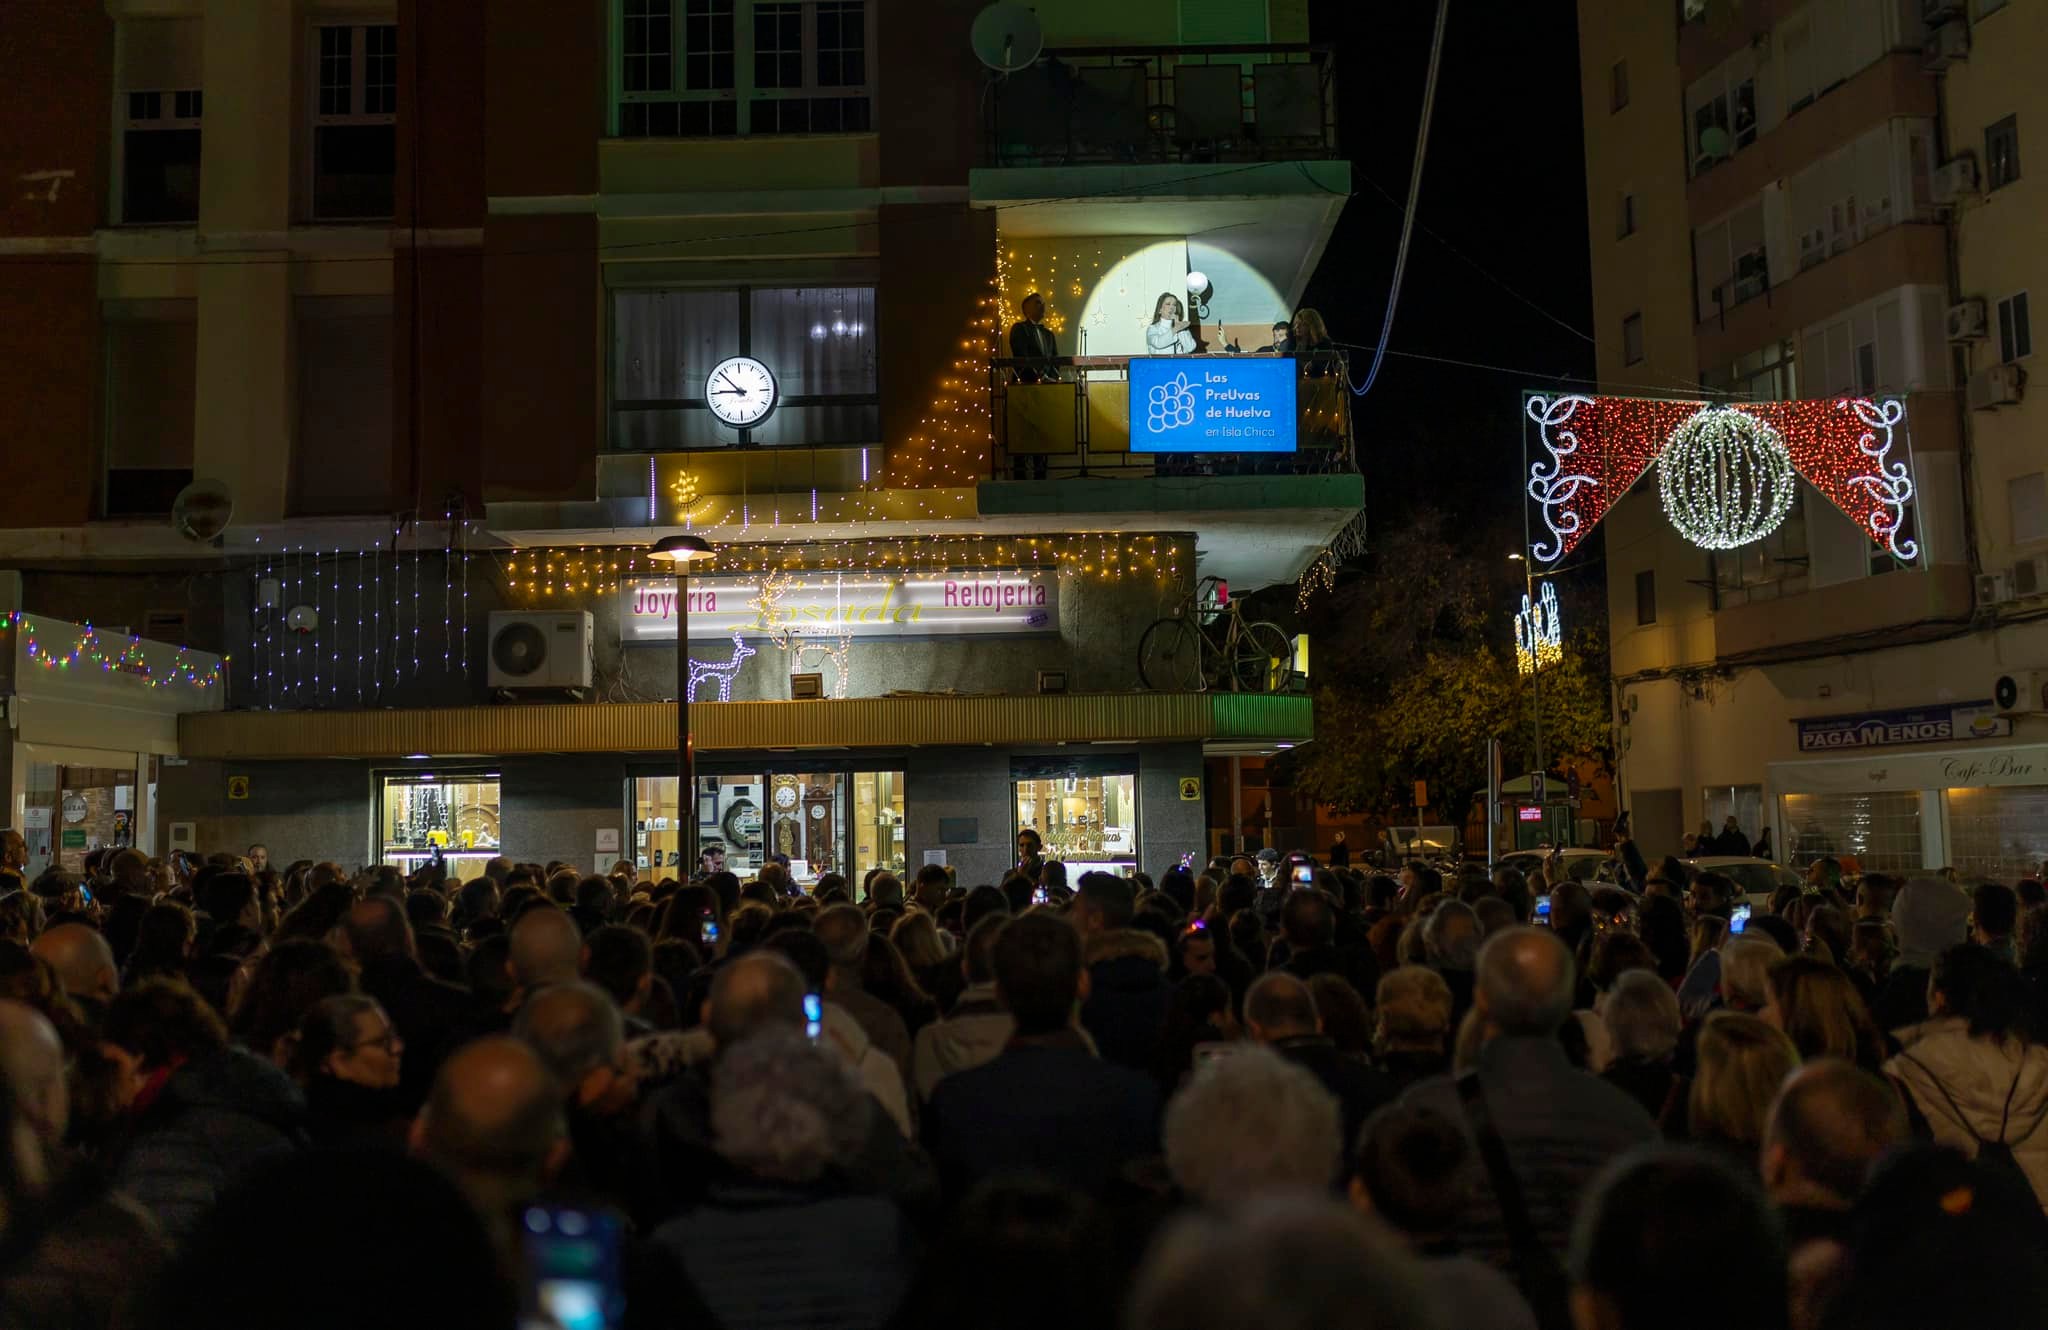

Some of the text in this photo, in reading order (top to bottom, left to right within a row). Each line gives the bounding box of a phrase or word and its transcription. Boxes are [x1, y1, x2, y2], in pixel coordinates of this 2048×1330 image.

[1205, 372, 1228, 383] Las
[1205, 389, 1260, 401] PreUvas
[1205, 406, 1271, 418] de Huelva
[1205, 428, 1219, 437] en
[1244, 426, 1275, 437] Chica
[944, 579, 1046, 612] Relojería
[634, 586, 717, 619] Joyría
